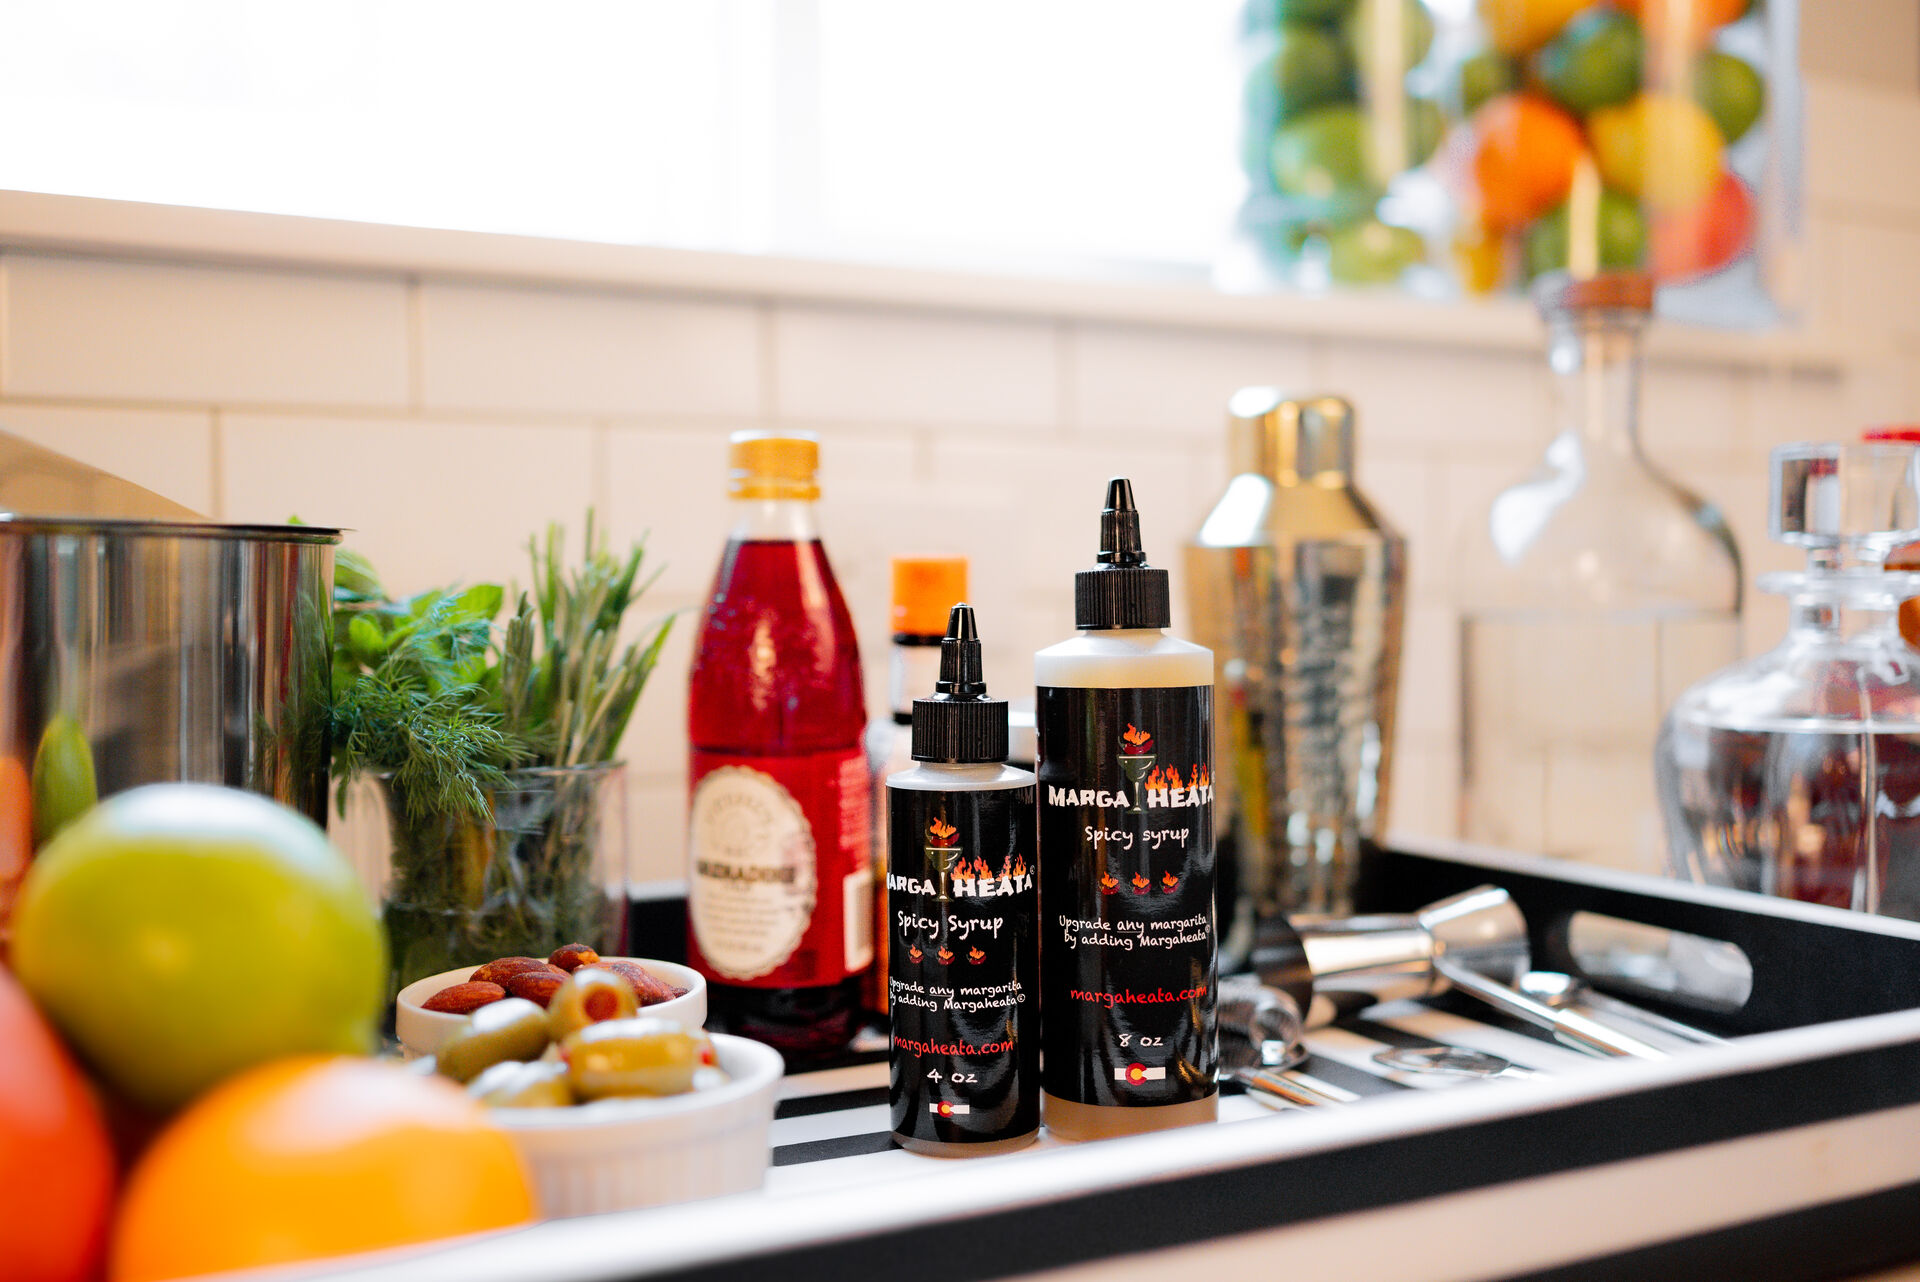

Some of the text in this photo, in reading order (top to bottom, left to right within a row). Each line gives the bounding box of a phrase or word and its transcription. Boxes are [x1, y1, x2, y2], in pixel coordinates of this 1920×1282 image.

[1048, 785, 1130, 808] MARGA
[1085, 826, 1189, 850] Spicy syrup
[897, 910, 1004, 940] Spicy Syrup
[1059, 913, 1207, 938] Upgrade any margarita
[1064, 929, 1077, 949] by
[1082, 932, 1133, 951] adding
[889, 975, 1023, 998] Upgrade any margarita
[1070, 985, 1207, 1009] margaheata.com
[898, 993, 938, 1012] adding
[894, 1035, 1014, 1058] margaheata.com
[1118, 1033, 1164, 1047] 8 oz
[927, 1068, 978, 1084] 4 oz
